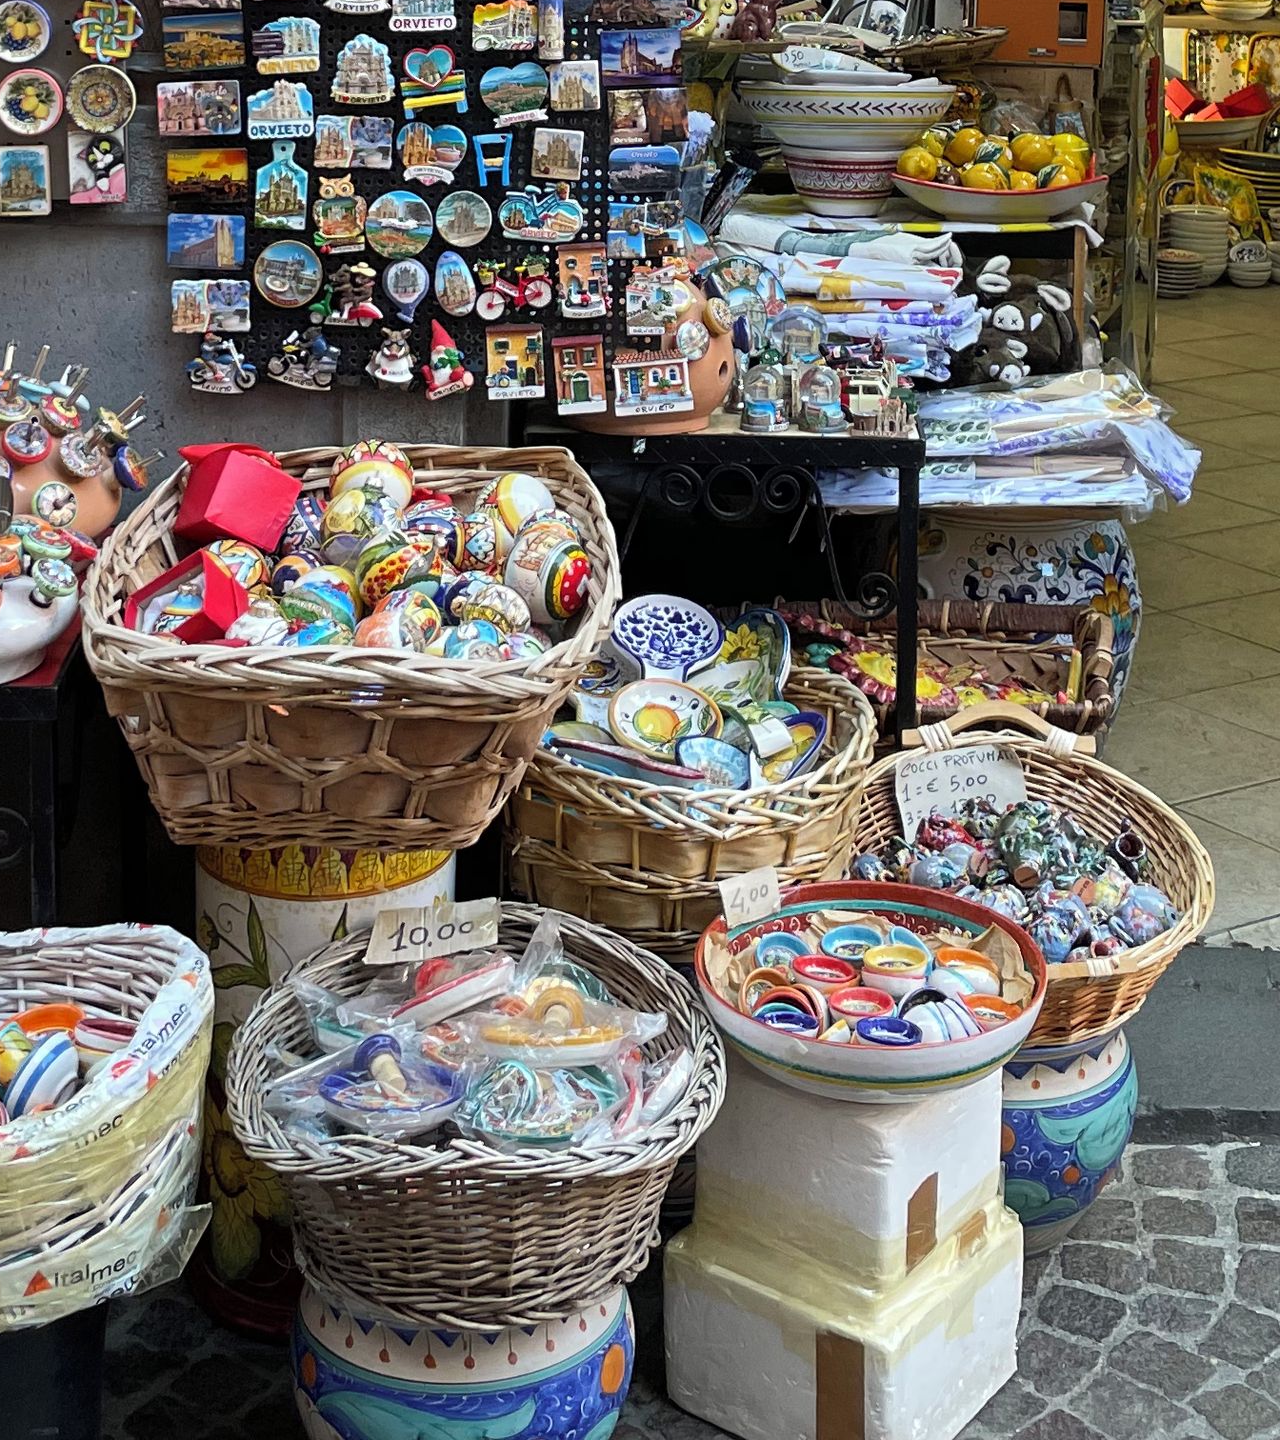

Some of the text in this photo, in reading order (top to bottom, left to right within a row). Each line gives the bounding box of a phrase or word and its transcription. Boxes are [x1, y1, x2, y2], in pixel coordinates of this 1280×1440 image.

[334, 1, 380, 12] ORVIETO
[393, 17, 454, 30] ORVIETO
[258, 59, 317, 74] ORVIETO
[349, 93, 387, 104] ORVIETO
[250, 122, 312, 138] ORVIETO
[613, 136, 644, 144] Orvieto
[494, 389, 538, 399] ORVIETO
[635, 402, 676, 414] ORVIETO
[900, 760, 938, 778] COCCI
[950, 774, 988, 793] 5,00
[729, 881, 770, 913] 4,00
[387, 919, 475, 953] 10,00
[53, 1248, 141, 1288] italmec
